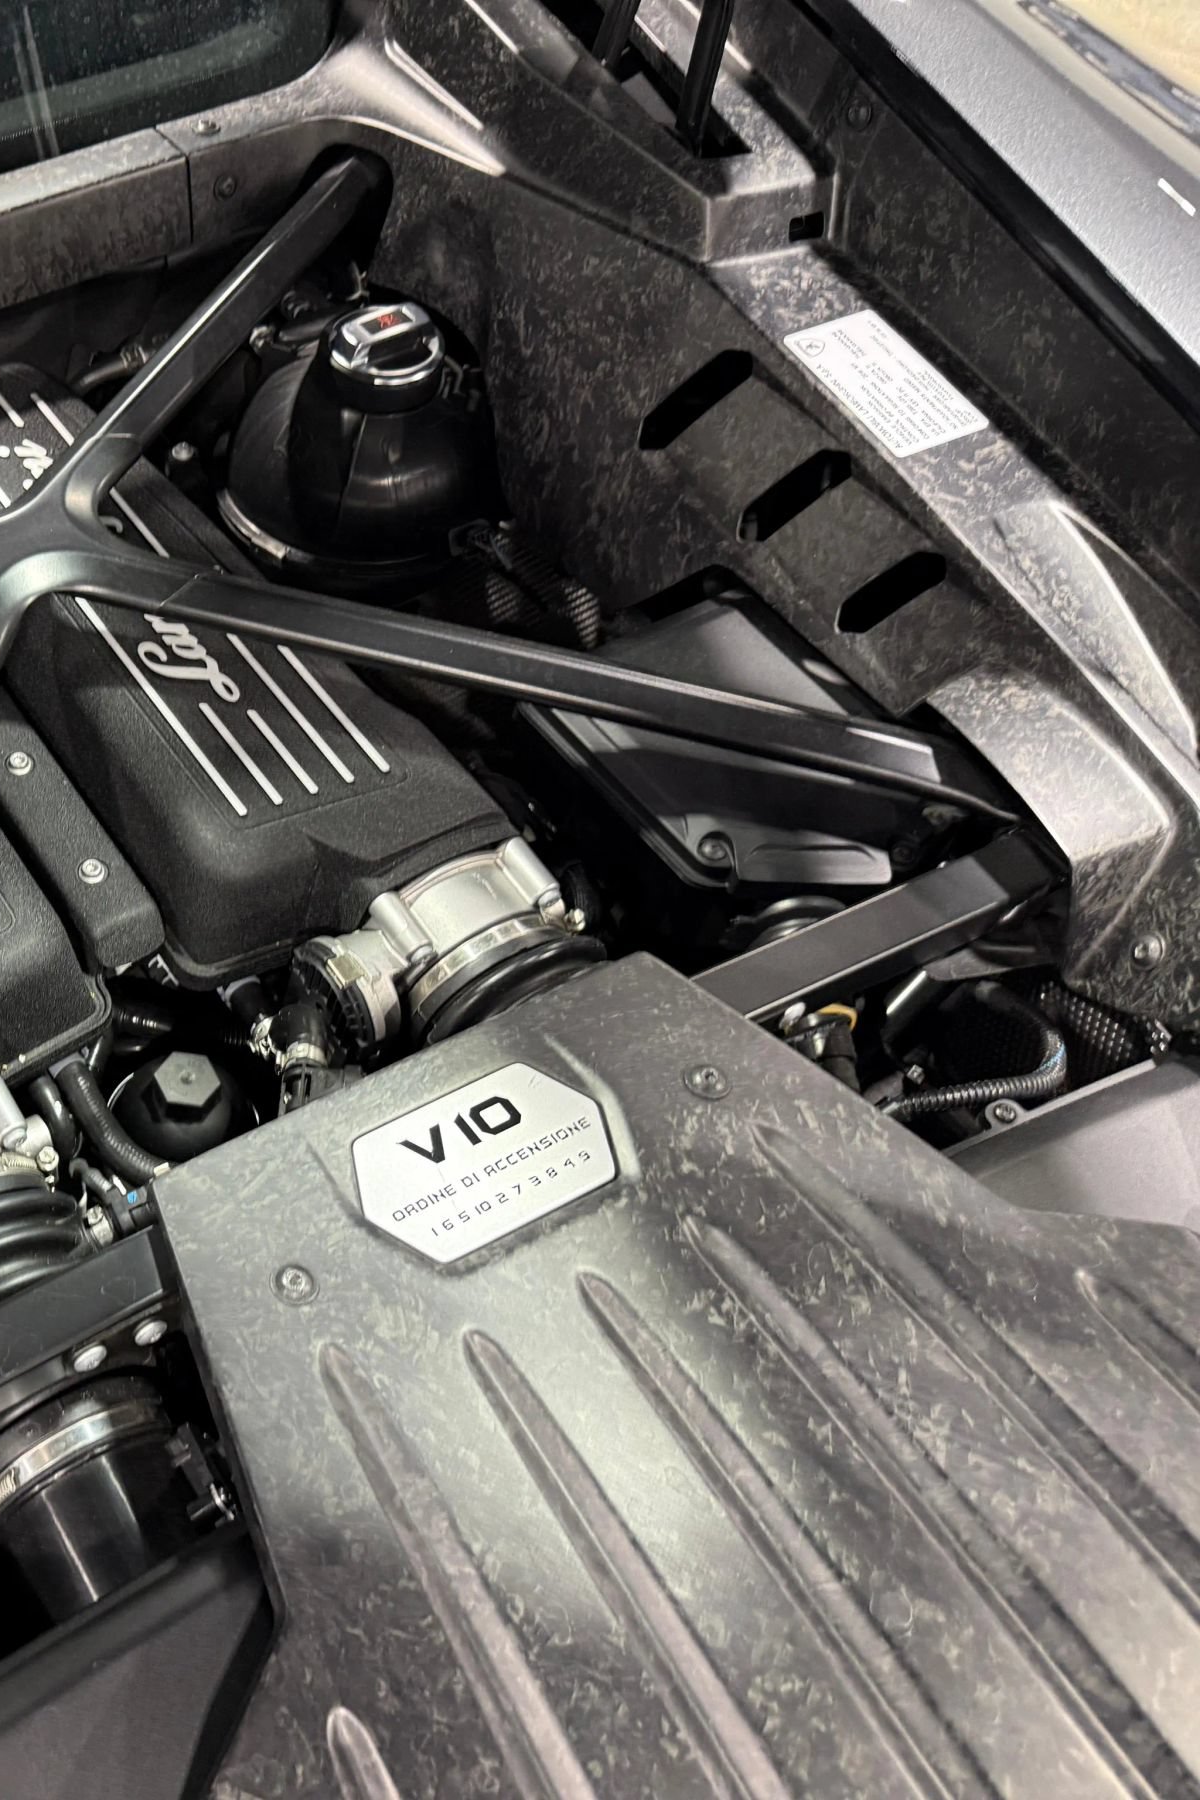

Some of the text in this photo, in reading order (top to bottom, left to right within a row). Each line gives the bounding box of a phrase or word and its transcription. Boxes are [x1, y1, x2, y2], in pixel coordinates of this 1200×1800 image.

[392, 1117, 591, 1222] ORDINE DI ACCENSIONE
[396, 1096, 521, 1163] V10
